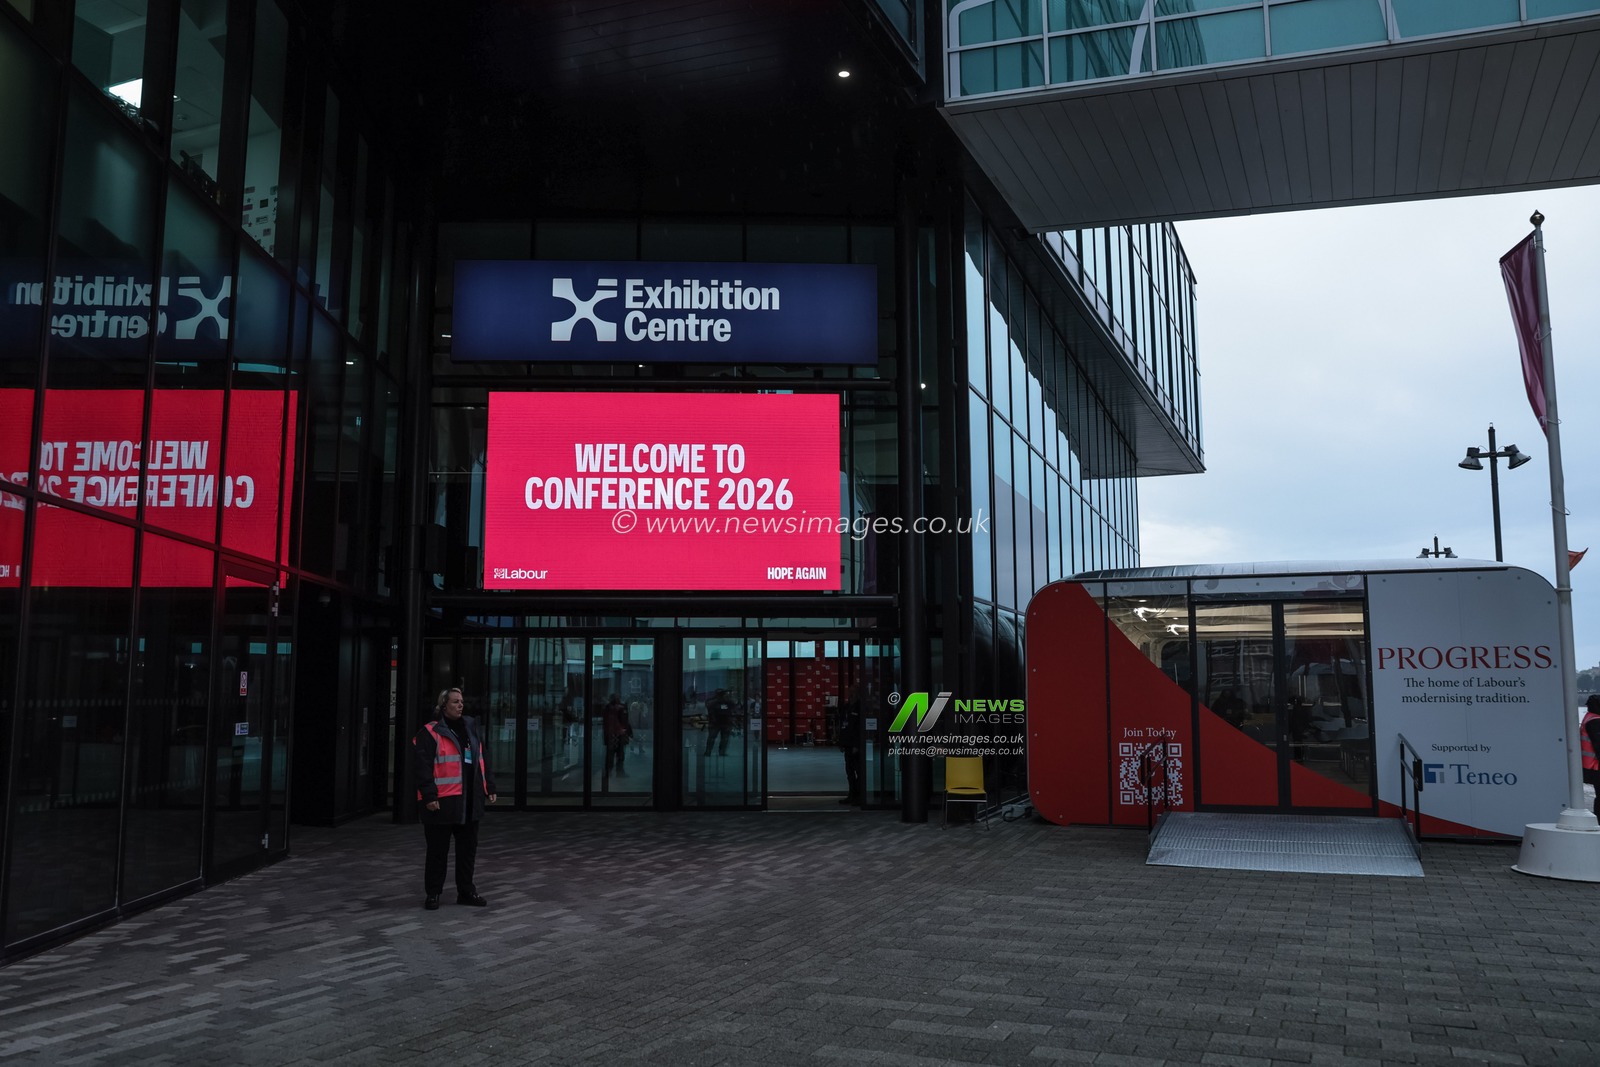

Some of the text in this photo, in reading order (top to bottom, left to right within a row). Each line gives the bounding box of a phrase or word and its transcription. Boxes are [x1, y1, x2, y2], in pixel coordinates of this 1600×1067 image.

[624, 278, 780, 310] Exhibition
[623, 310, 732, 342] Centre
[574, 443, 745, 473] WELCOME TO
[524, 477, 794, 511] CONFERENCE 2026
[505, 568, 548, 580] Labour
[767, 567, 827, 580] HOPE AGAIN
[1404, 677, 1425, 688] The
[1428, 677, 1459, 688] home
[1462, 677, 1475, 688] of
[1402, 693, 1530, 706] modernising tradition.
[1123, 727, 1177, 740] Join Today
[1432, 744, 1491, 753] Supported by
[1449, 764, 1518, 785] Teneo
